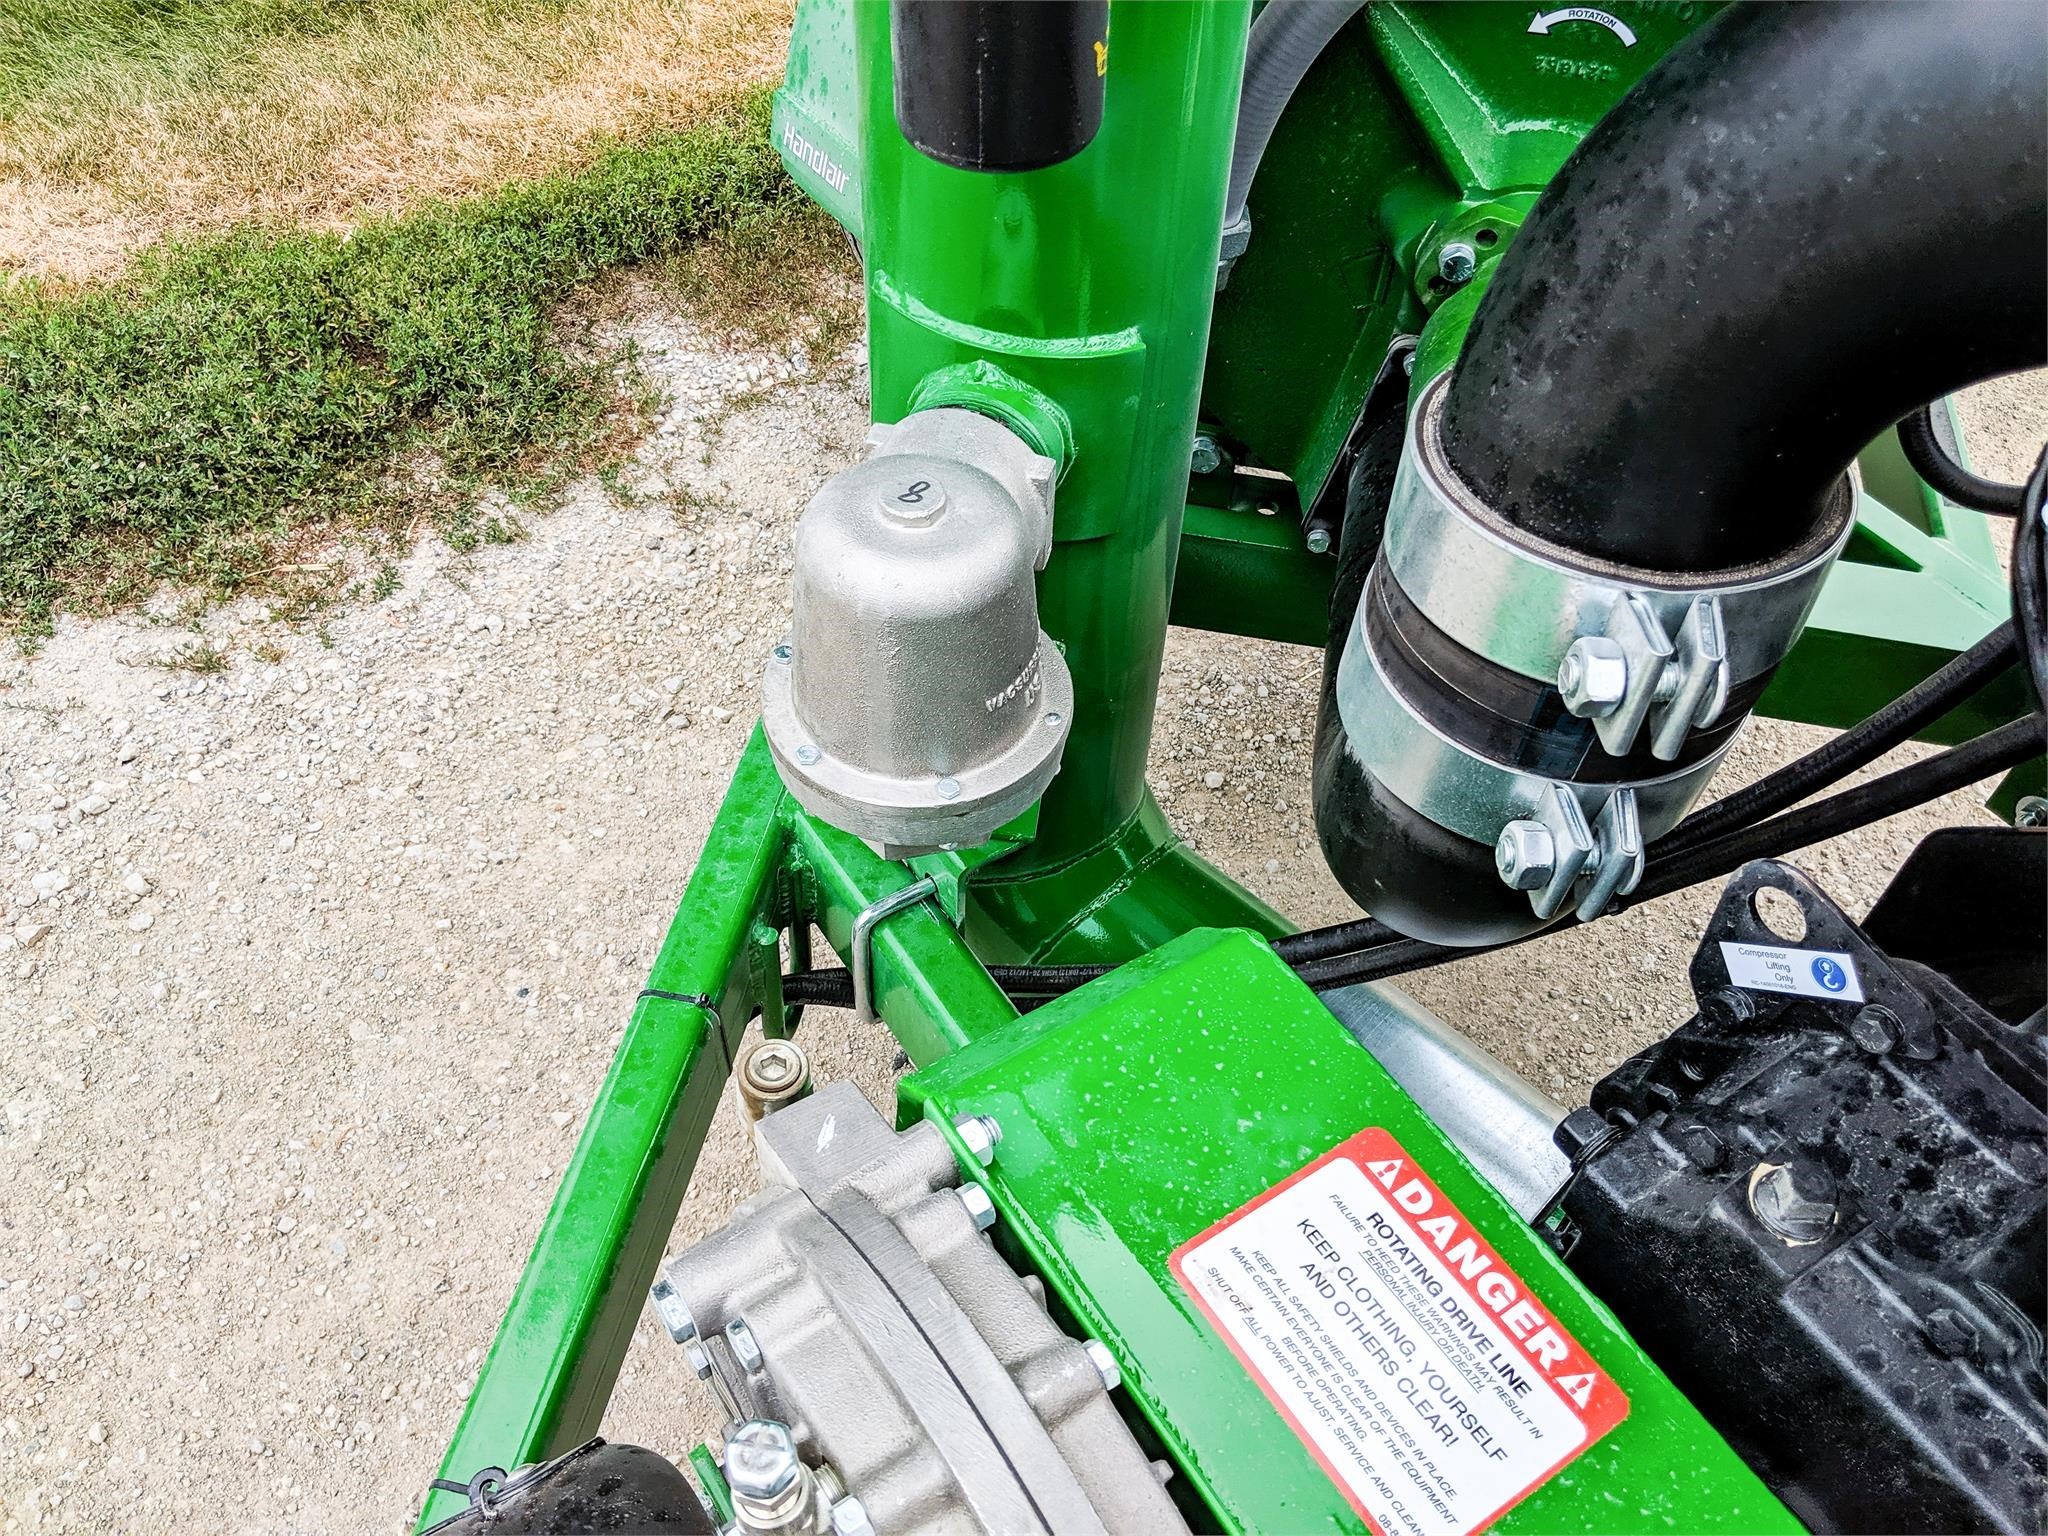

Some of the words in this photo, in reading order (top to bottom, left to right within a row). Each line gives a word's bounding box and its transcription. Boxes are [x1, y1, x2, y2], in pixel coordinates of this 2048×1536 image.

[1567, 9, 1617, 28] ROTATION
[783, 121, 850, 194] Handlair
[897, 480, 931, 503] 8
[1738, 947, 1787, 960] Compressor
[1765, 961, 1791, 973] Lifting
[1774, 973, 1794, 984] Only
[1297, 1218, 1341, 1262] KEEP
[1337, 1266, 1416, 1363] CLOTHING,
[1420, 1361, 1508, 1461] YOURSELF
[1299, 1264, 1336, 1299] AND
[1334, 1301, 1399, 1376] OTHERS
[1397, 1378, 1459, 1447] CLEAR!
[1329, 1194, 1366, 1232] FAILURE
[1363, 1233, 1378, 1246] TO
[1375, 1247, 1400, 1273] HEED
[1399, 1275, 1430, 1306] THESE
[1427, 1307, 1475, 1361] WARNINGS
[1472, 1362, 1496, 1383] MAY
[1493, 1385, 1533, 1424] RESULT
[1529, 1427, 1543, 1439] IN
[1362, 1250, 1407, 1301] PERSONAL
[1406, 1302, 1440, 1335] INJURY
[1437, 1338, 1454, 1354] OR
[1451, 1355, 1485, 1391] DEATH.
[1366, 1212, 1443, 1298] ROTATING
[1439, 1297, 1494, 1355] DRIVE
[1489, 1353, 1532, 1399] LINE
[1392, 1178, 1569, 1372] DANGER
[1208, 1268, 1233, 1292] SHUT
[1229, 1295, 1250, 1314] OFF
[1245, 1317, 1262, 1335] ALL
[1261, 1335, 1294, 1373] POWER
[1292, 1373, 1307, 1389] TO
[1334, 1428, 1375, 1474] SERVICE
[1370, 1477, 1394, 1499] AND
[1229, 1247, 1256, 1274] MAKE
[1253, 1275, 1290, 1317] CERTAIN
[1286, 1317, 1335, 1372] EVERYONE
[1331, 1373, 1344, 1384] IS
[1341, 1385, 1372, 1419] CLEAR
[1370, 1421, 1386, 1435] OF
[1384, 1437, 1406, 1460] THE
[1401, 1461, 1458, 1524] EQUIPMENT
[1252, 1250, 1277, 1275] KEEP
[1273, 1278, 1290, 1295] ALL
[1289, 1296, 1324, 1332] SAFETY
[1320, 1335, 1358, 1377] SHIELDS
[1355, 1380, 1377, 1400] AND
[1374, 1401, 1416, 1448] DEVICES
[1412, 1449, 1427, 1461] IN
[1423, 1462, 1457, 1501] PLACE.
[1282, 1337, 1319, 1378] BEFORE
[1316, 1379, 1367, 1442] OPERATING.
